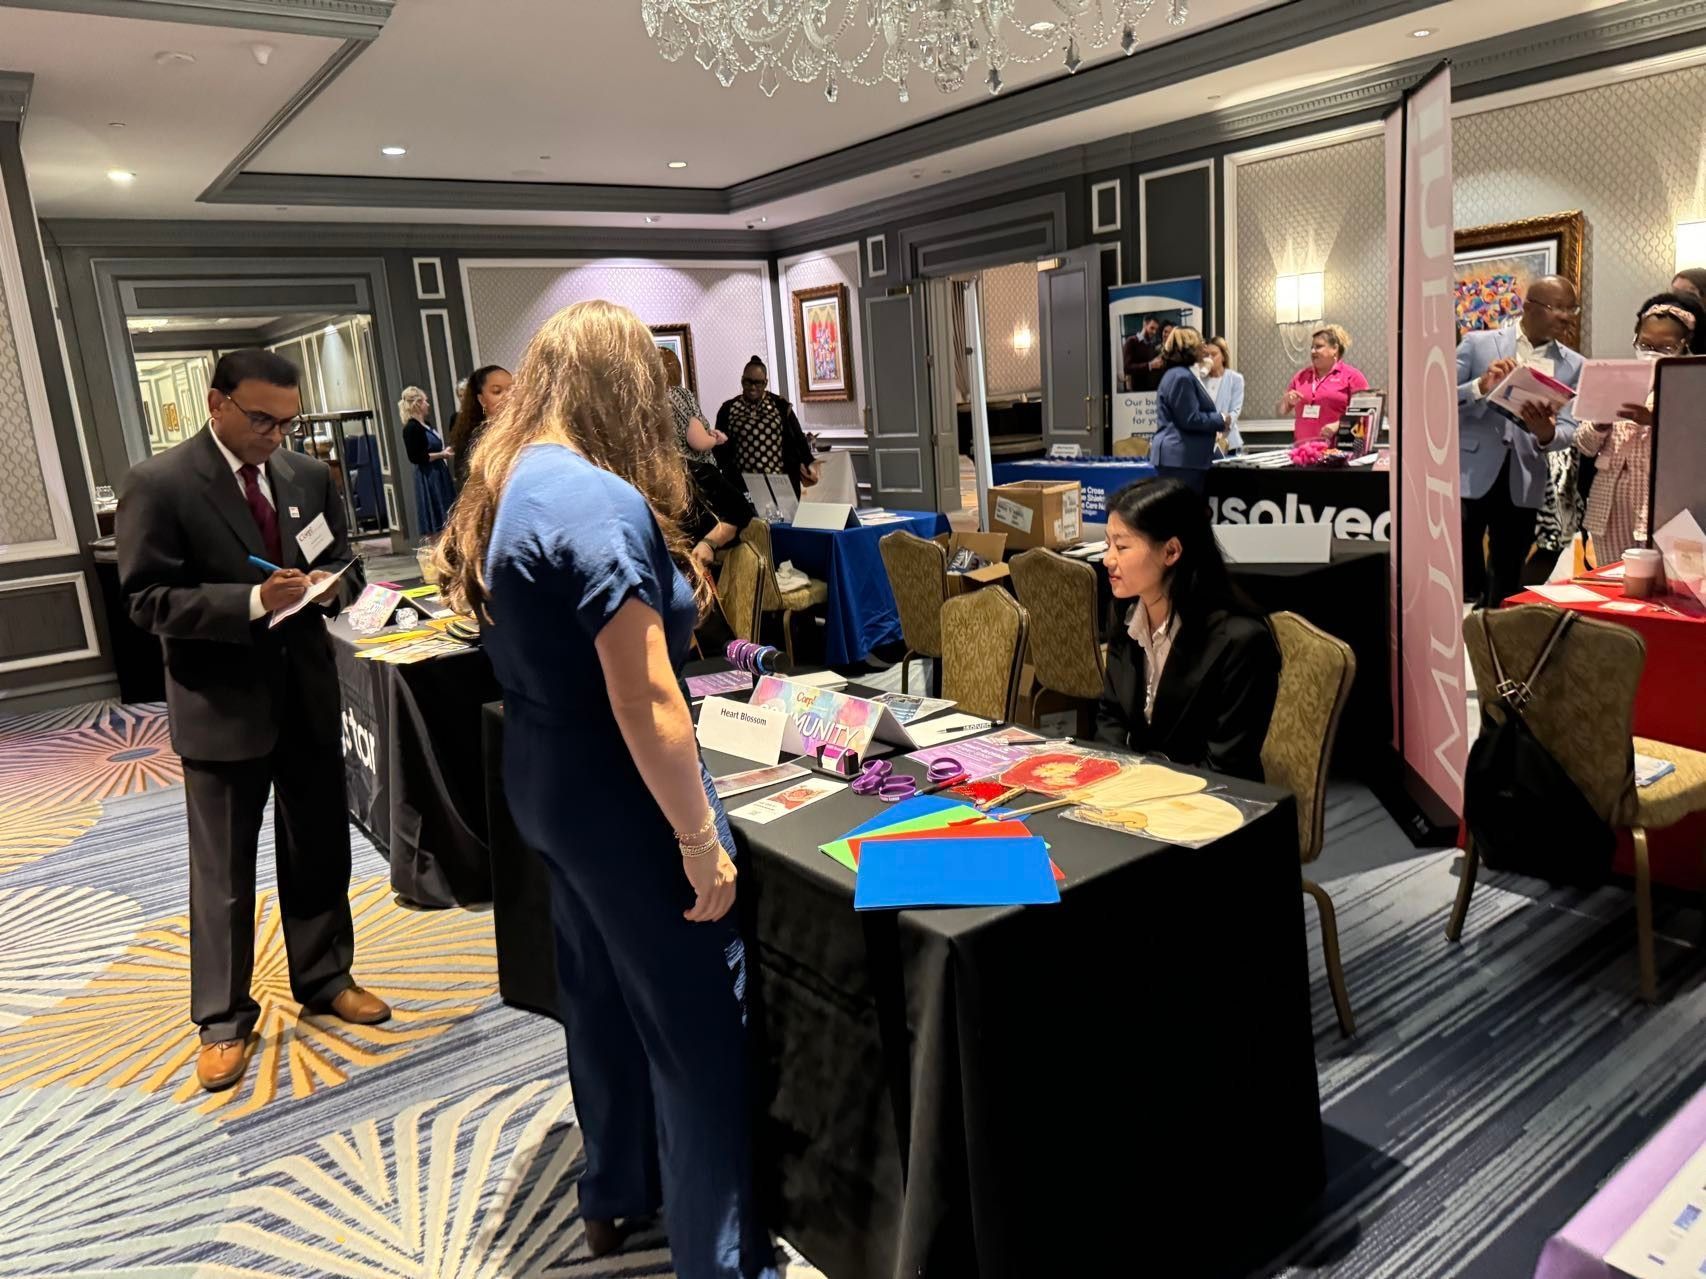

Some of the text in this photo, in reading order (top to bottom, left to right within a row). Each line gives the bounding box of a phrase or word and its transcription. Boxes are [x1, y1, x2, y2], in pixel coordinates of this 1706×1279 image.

[1124, 398, 1142, 407] Our
[1132, 417, 1145, 425] for
[1087, 486, 1105, 495] Cross
[796, 691, 817, 707] Corp!
[720, 708, 767, 726] Heart Blossom
[340, 706, 377, 776] star
